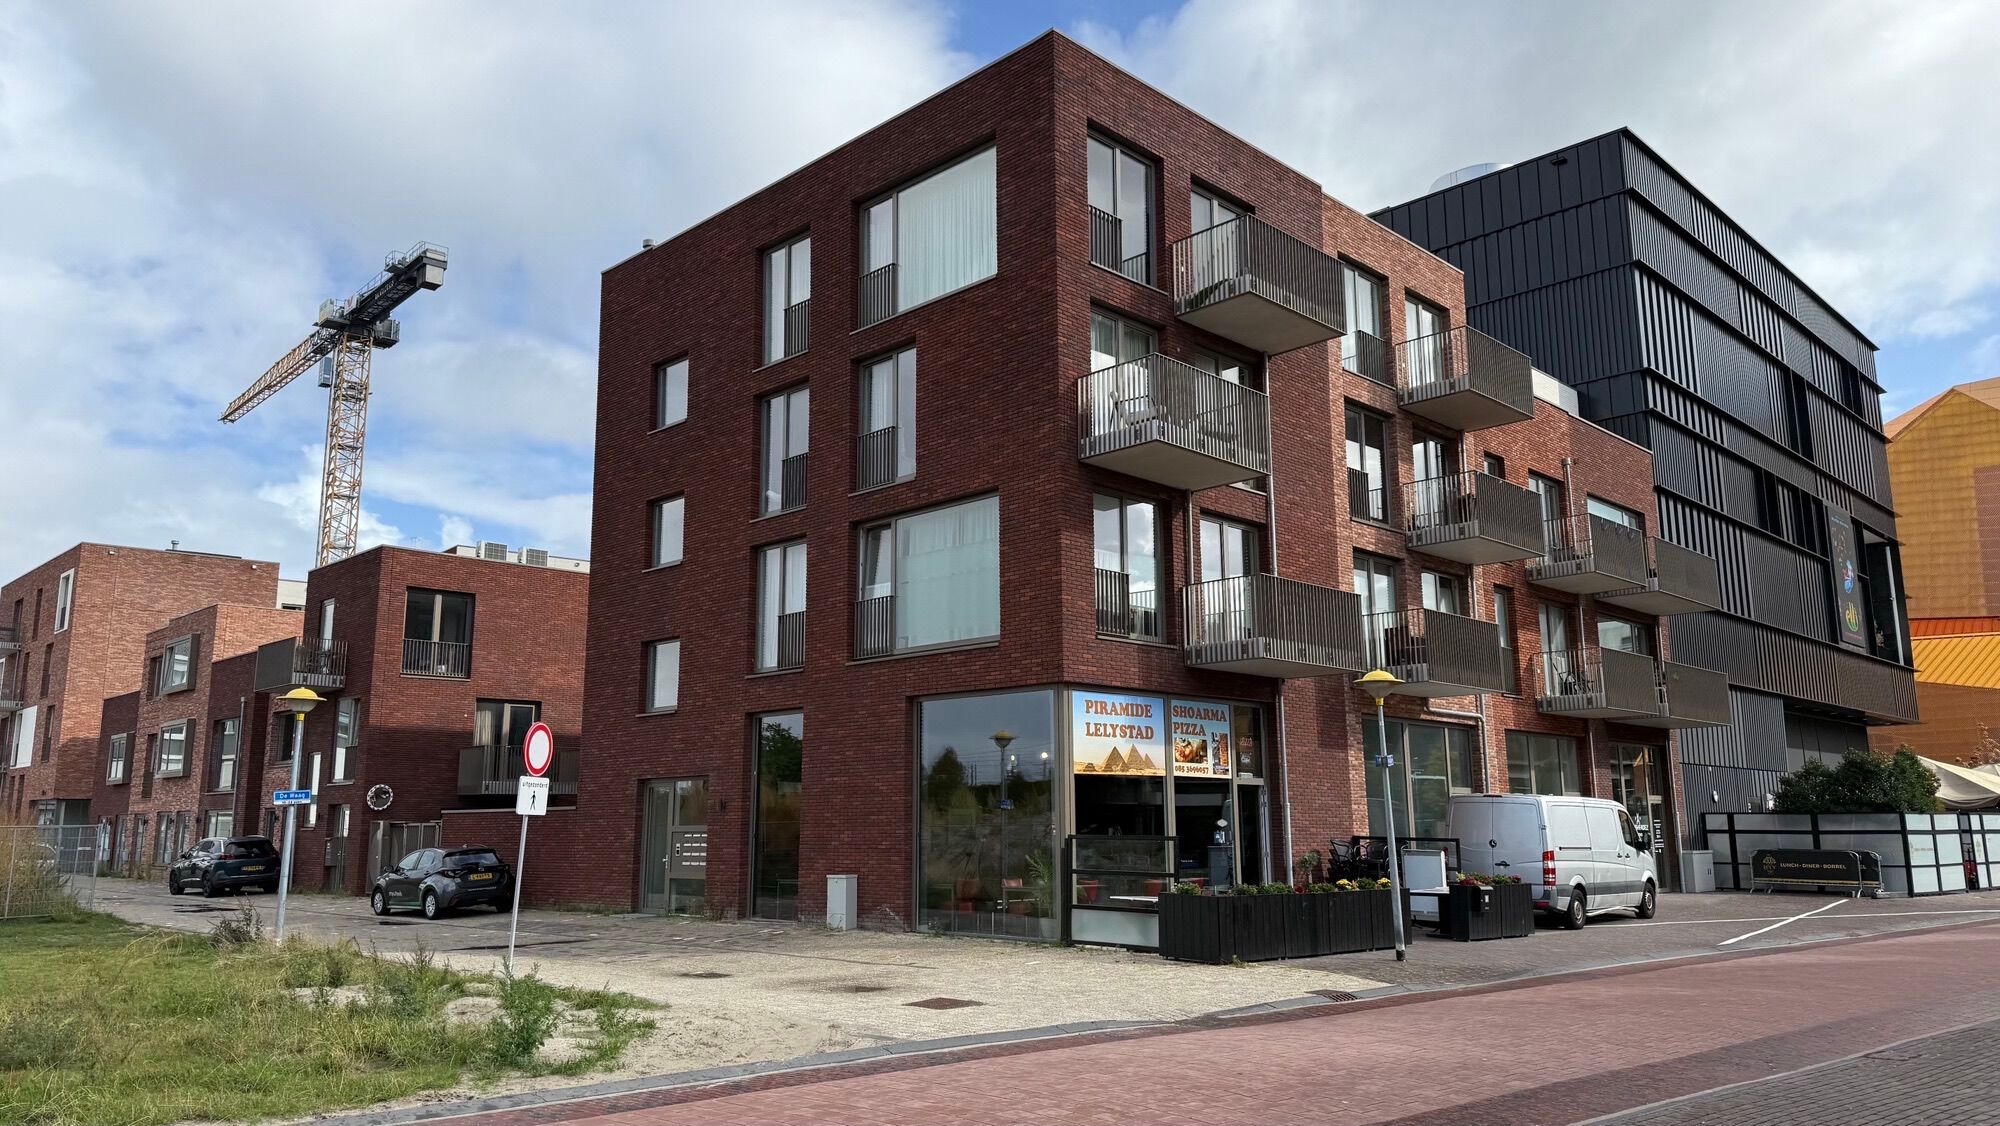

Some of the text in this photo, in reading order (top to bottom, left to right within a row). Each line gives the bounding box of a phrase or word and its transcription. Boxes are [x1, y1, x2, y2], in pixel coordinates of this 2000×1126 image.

[1084, 699, 1153, 719] PIRAMIDE
[1172, 704, 1228, 722] SHOARMA
[1085, 722, 1154, 740] LELYSTAD
[1172, 721, 1207, 737] PIZZA
[1174, 765, 1185, 773] 085
